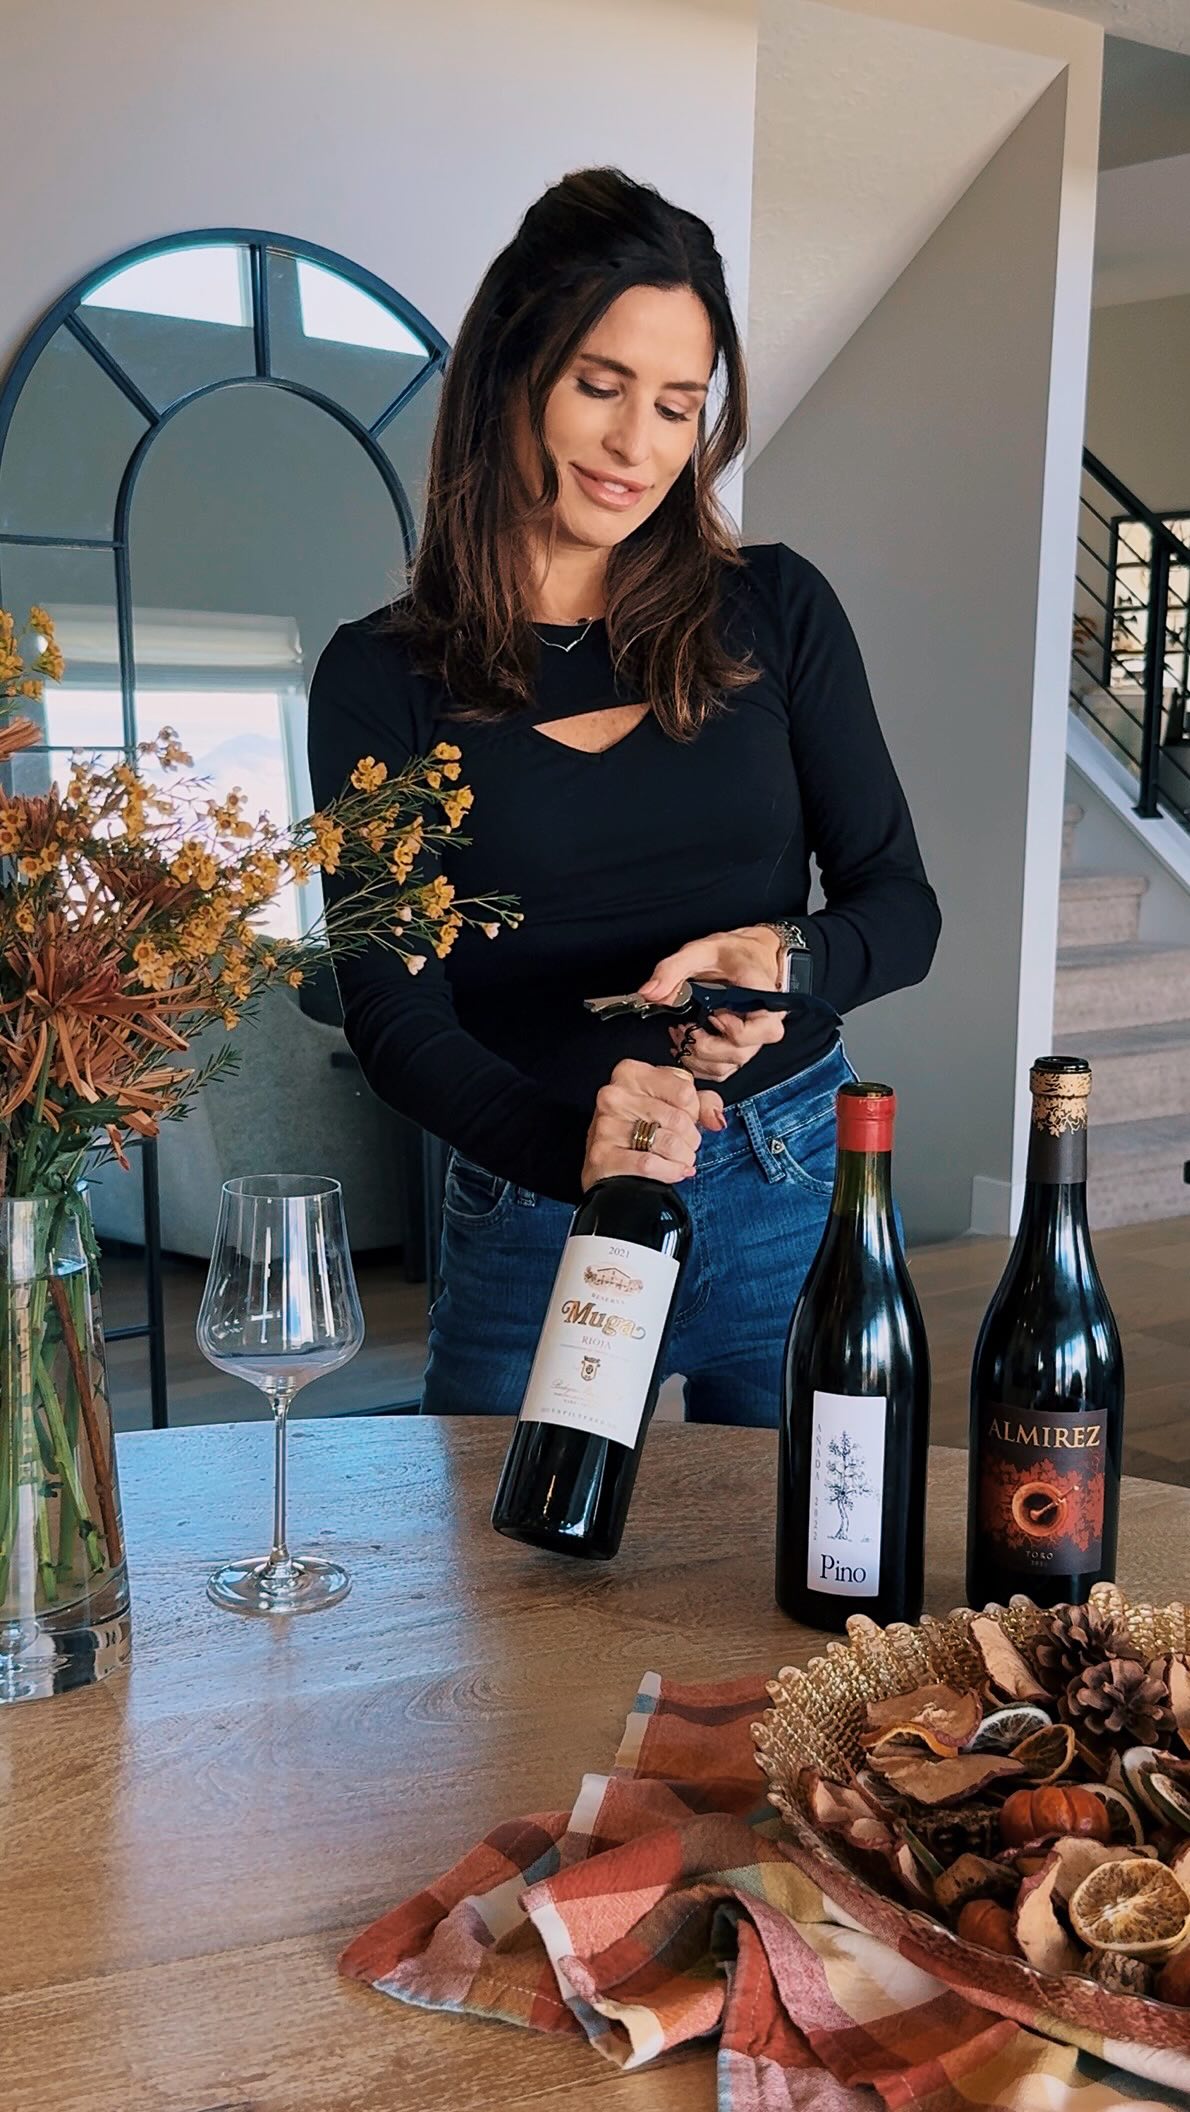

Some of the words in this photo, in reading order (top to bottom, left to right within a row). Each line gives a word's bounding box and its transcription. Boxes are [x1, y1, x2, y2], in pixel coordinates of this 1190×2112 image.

[608, 1246, 630, 1259] 2021
[561, 1300, 646, 1340] Muga
[581, 1335, 612, 1350] RIOJA
[989, 1418, 1101, 1449] ALMIREZ
[1025, 1550, 1054, 1560] TORO
[820, 1553, 867, 1583] Pino
